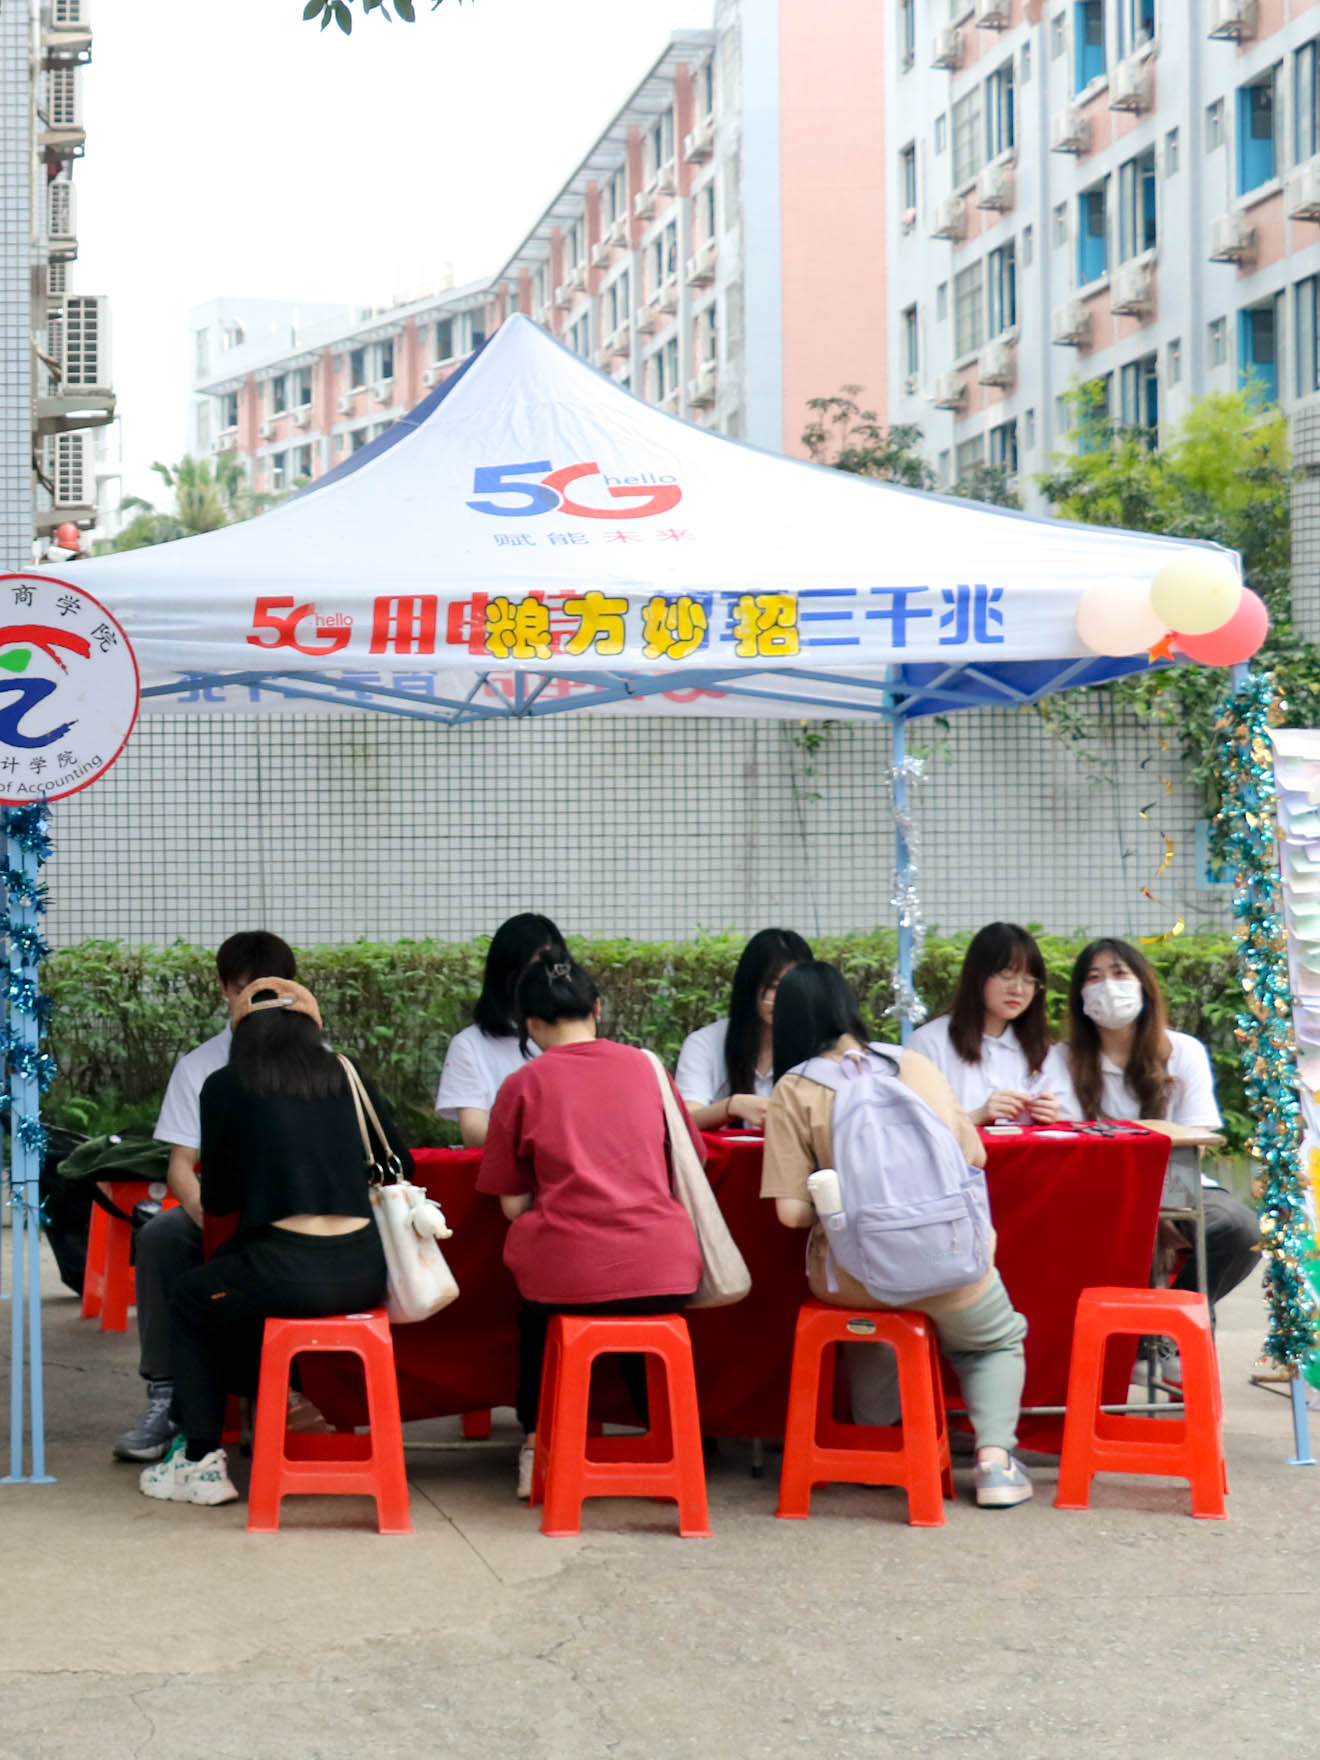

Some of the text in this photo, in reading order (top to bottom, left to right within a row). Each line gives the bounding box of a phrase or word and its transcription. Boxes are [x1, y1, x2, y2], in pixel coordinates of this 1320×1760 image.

[465, 460, 682, 519] 5G
[603, 473, 677, 485] hello
[246, 596, 351, 656] 5G
[315, 614, 354, 627] hello
[485, 590, 800, 660] 粮方妙招
[16, 754, 104, 794] Accounting
